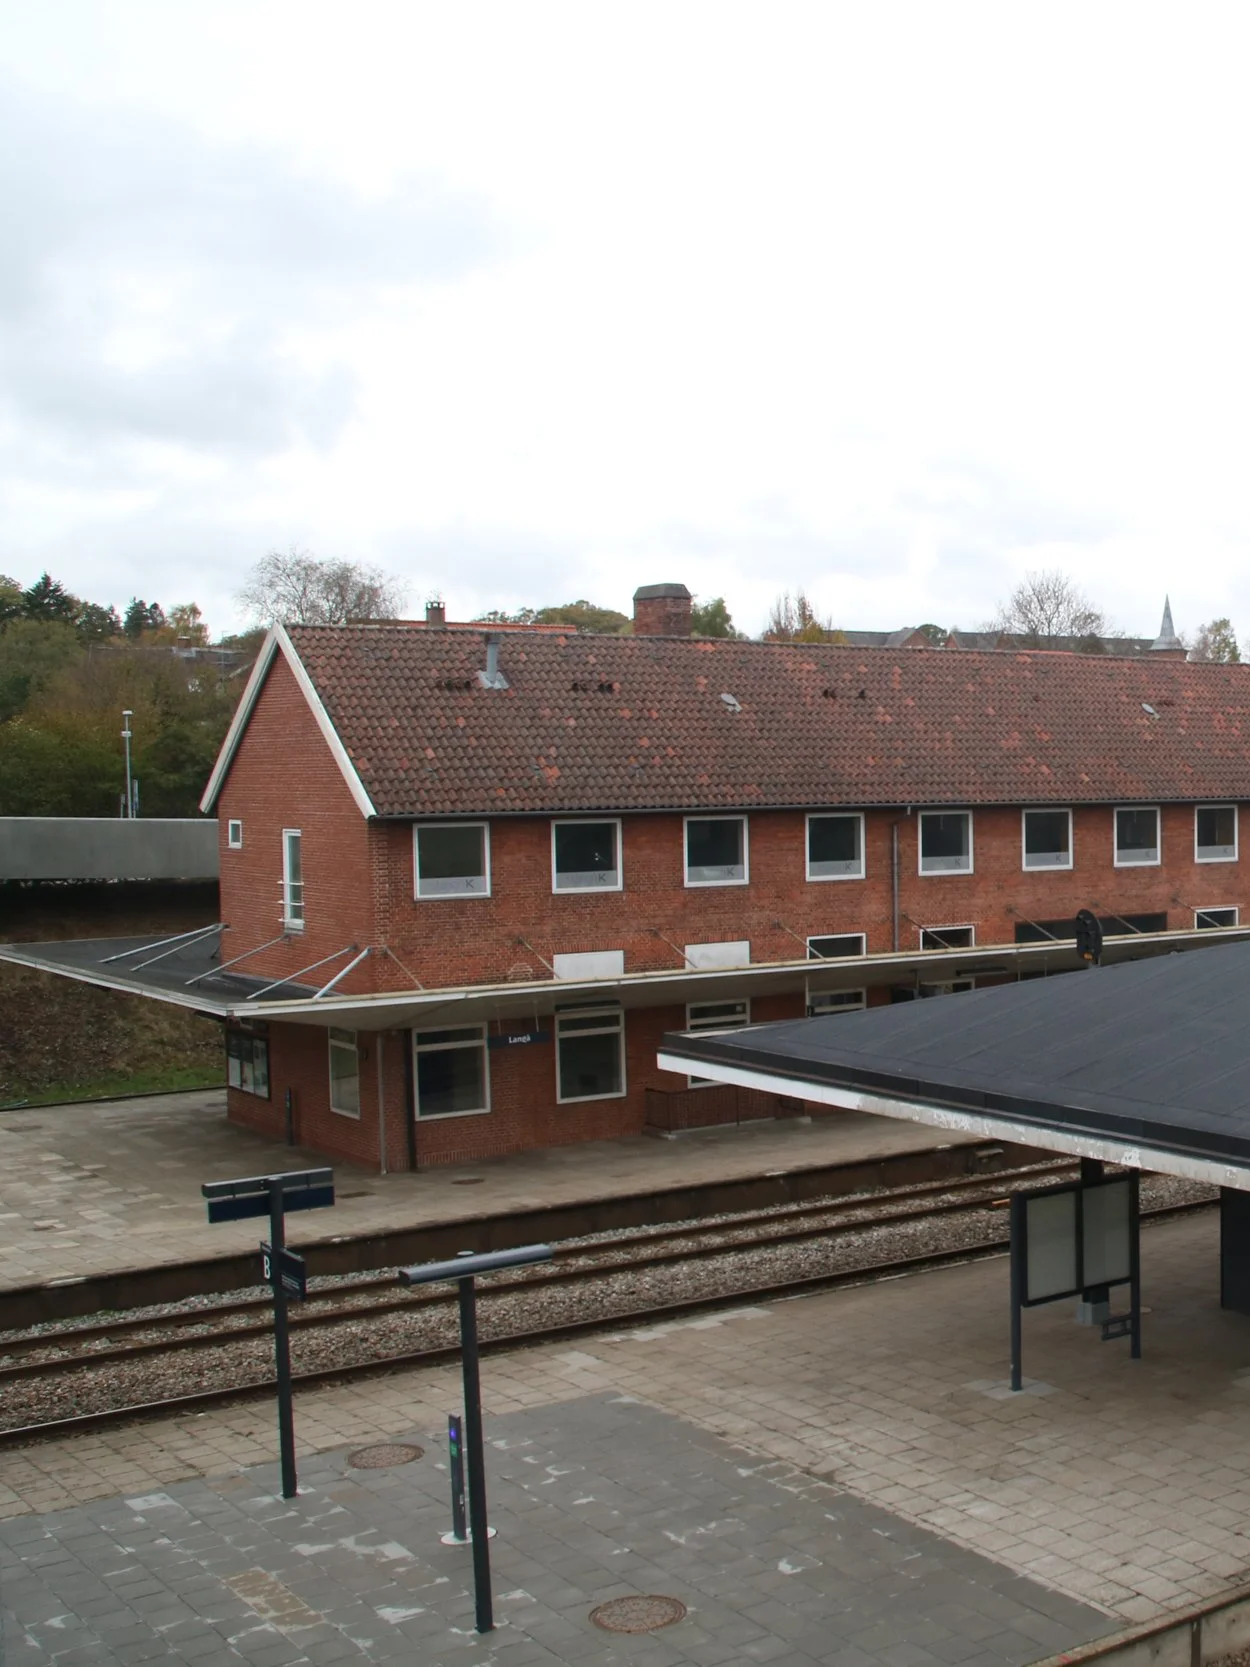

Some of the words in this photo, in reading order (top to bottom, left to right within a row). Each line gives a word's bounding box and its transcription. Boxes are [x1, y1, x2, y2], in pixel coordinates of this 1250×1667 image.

[598, 873, 607, 882] K
[465, 879, 474, 889] K
[508, 1034, 531, 1044] Langå
[263, 1255, 271, 1279] B
